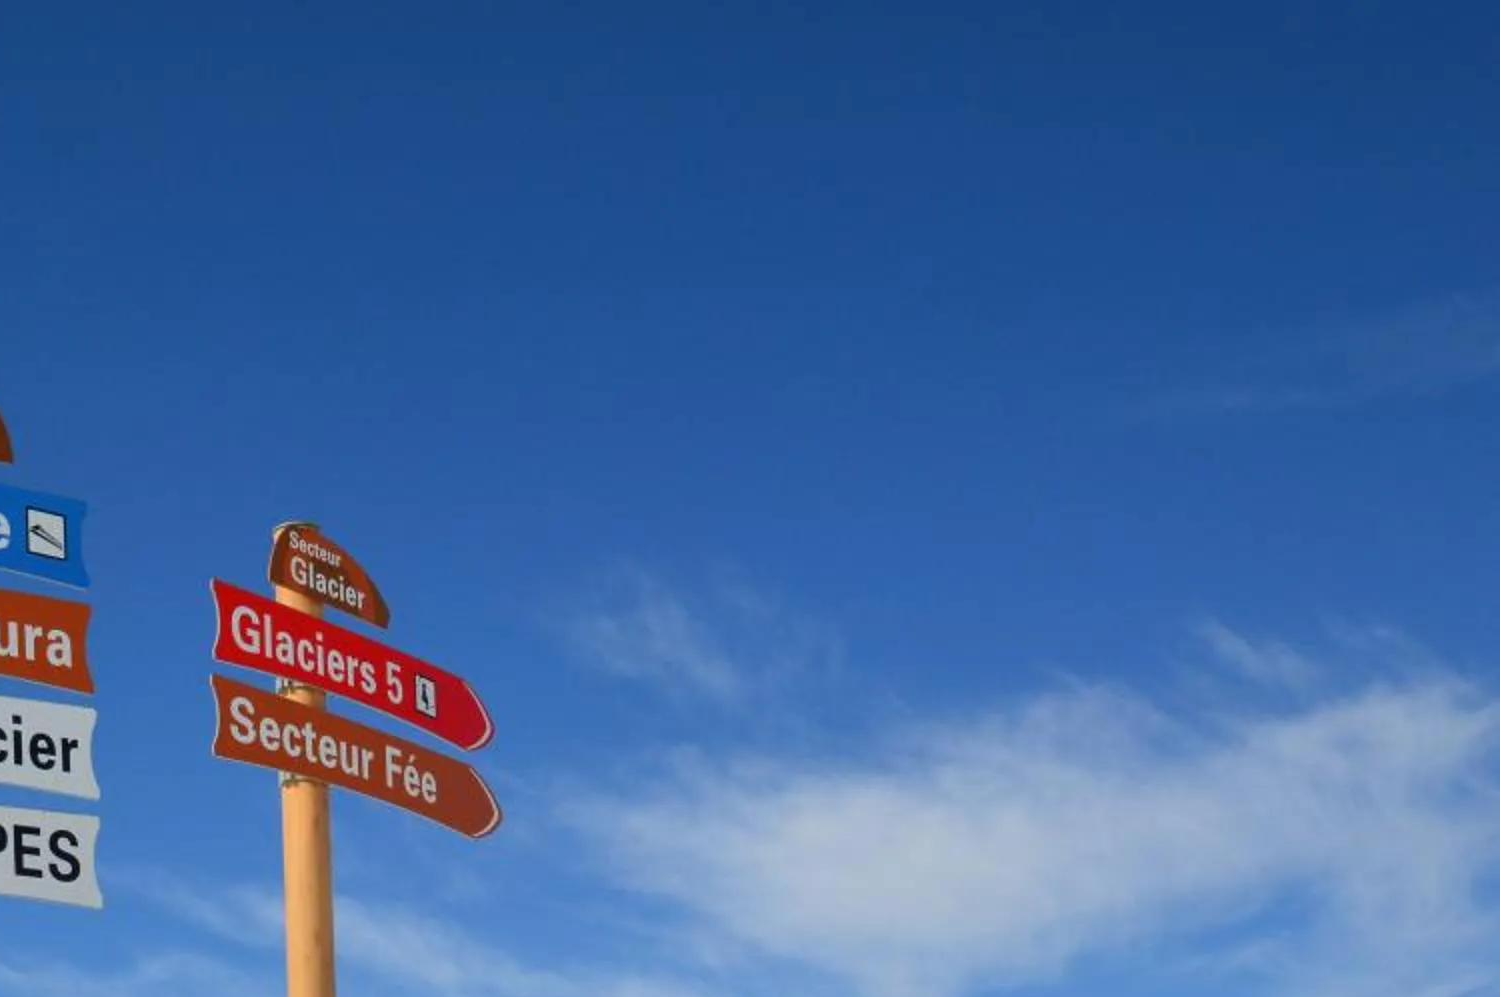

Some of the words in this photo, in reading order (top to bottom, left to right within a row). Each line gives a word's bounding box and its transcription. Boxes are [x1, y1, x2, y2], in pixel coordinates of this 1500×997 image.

[289, 530, 342, 567] Secteur
[290, 557, 366, 610] Glacier
[231, 605, 378, 695] Glaciers
[386, 661, 404, 705] 5
[229, 696, 374, 781] Secteur
[385, 744, 438, 804] Fée
